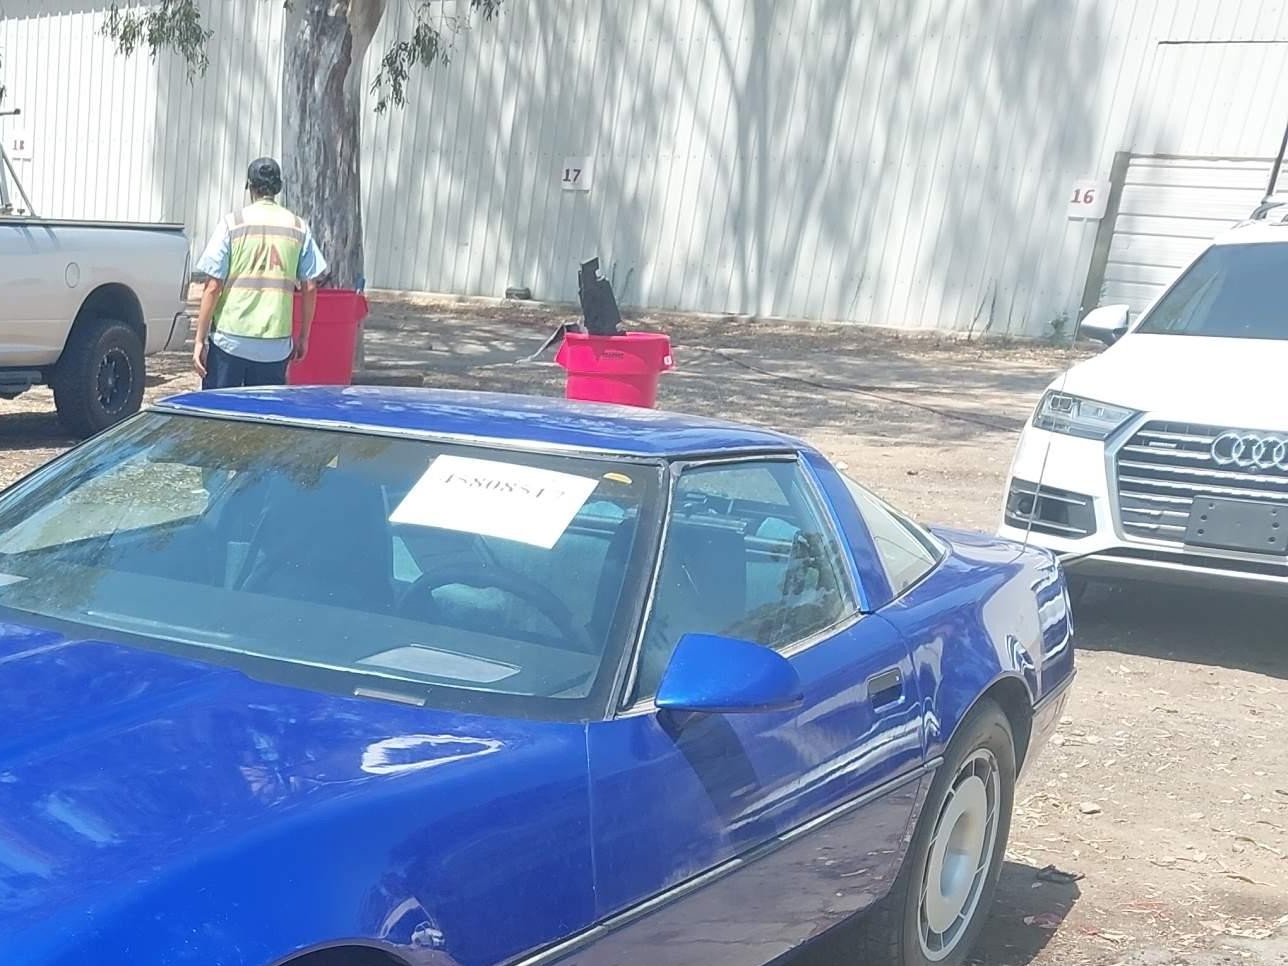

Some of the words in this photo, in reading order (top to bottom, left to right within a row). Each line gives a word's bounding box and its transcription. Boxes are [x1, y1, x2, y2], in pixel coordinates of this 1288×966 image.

[562, 168, 582, 182] 17
[1070, 188, 1096, 204] 16
[439, 472, 567, 502] 4580851
